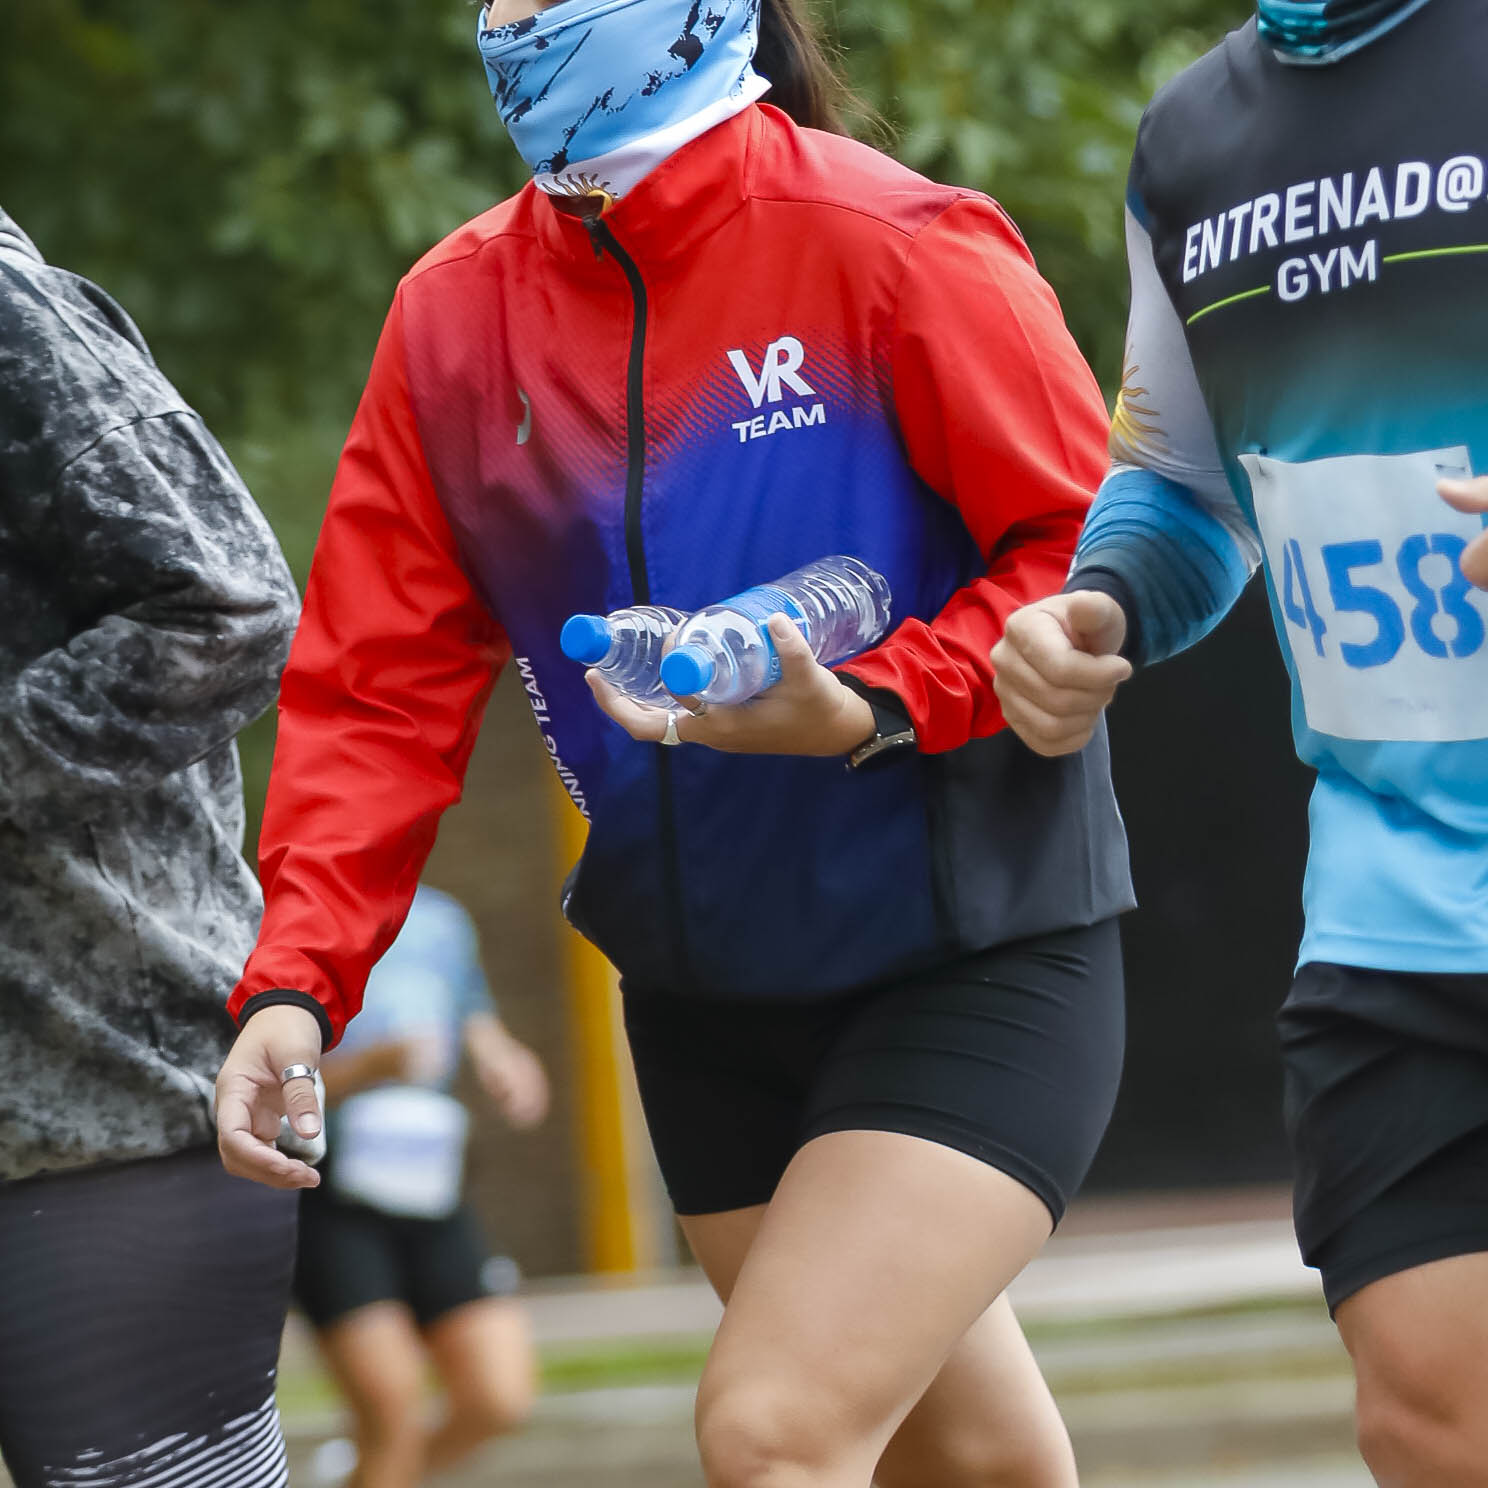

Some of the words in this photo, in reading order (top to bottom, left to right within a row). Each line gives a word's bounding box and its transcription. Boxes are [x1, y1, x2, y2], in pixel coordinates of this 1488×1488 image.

[1277, 239, 1377, 302] GYM
[726, 336, 817, 409] VR
[731, 403, 827, 443] TEAM
[1283, 532, 1486, 671] 458
[515, 657, 552, 726] TEAM
